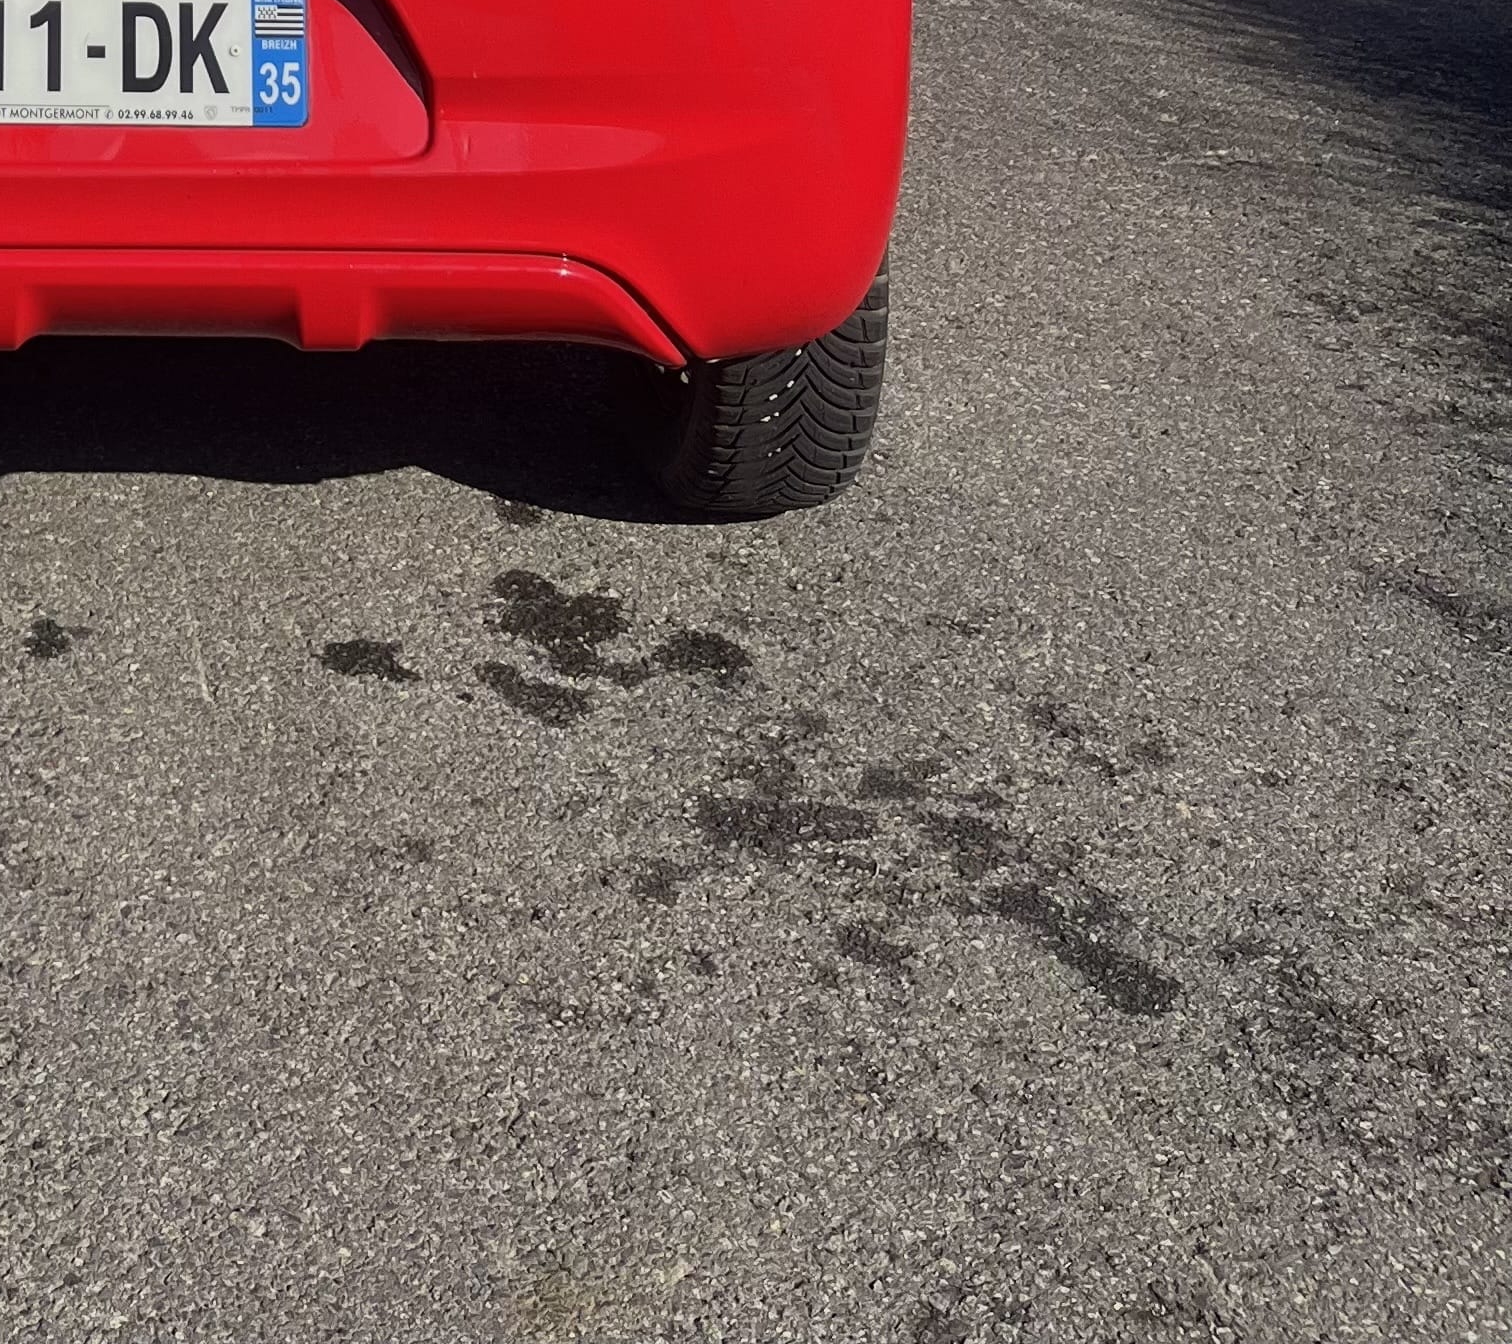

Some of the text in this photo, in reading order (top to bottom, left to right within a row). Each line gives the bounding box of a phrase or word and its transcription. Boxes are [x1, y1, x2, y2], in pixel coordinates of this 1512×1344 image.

[261, 39, 297, 50] BREIZH
[259, 62, 302, 105] 35
[9, 107, 100, 120] MONTGERMONT
